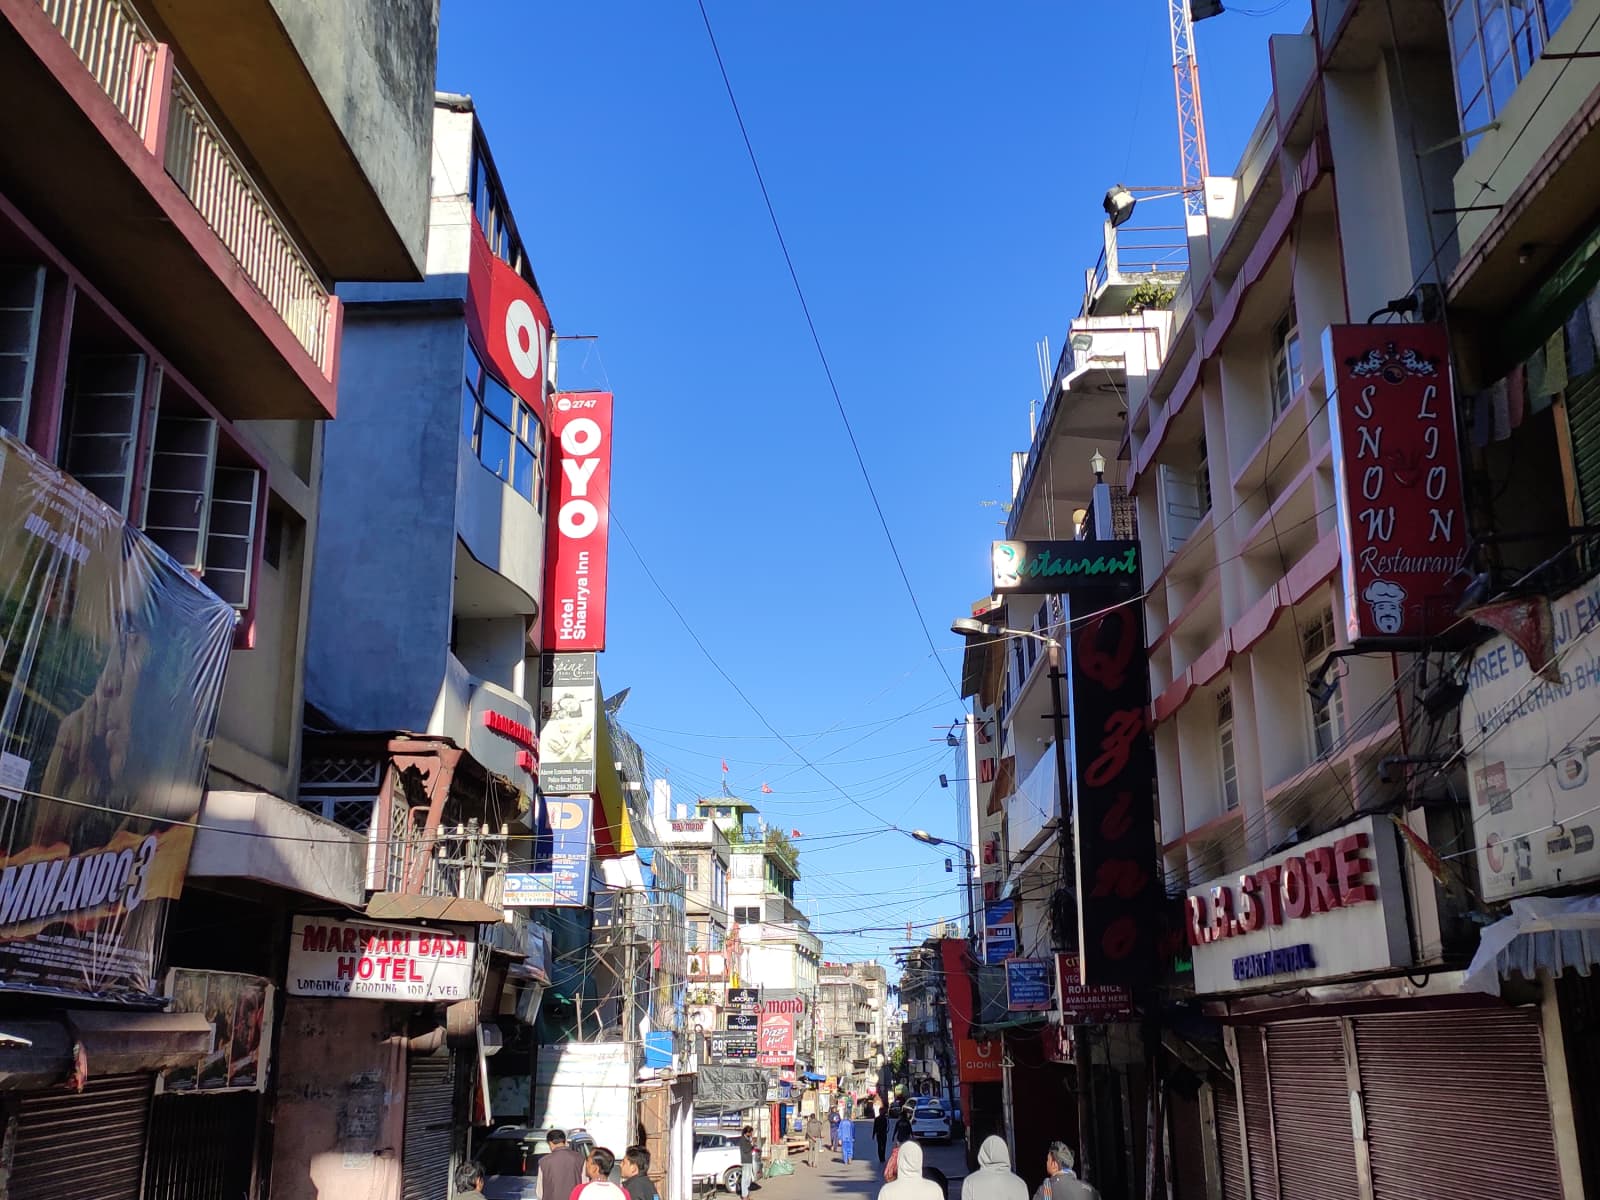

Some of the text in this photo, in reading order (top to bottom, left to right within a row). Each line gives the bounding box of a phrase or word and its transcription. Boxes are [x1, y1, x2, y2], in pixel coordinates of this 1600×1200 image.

[572, 400, 597, 409] 2747
[558, 417, 602, 539] OYO
[1355, 384, 1395, 543] SNOW
[1418, 384, 1454, 543] LION
[998, 544, 1137, 580] Restaurant
[573, 551, 591, 640] Shaurya Inn
[559, 598, 574, 640] Hotel
[125, 834, 158, 912] 3
[302, 924, 468, 959] MARWARI BASA
[337, 956, 424, 982] HOTEL
[297, 978, 341, 993] LODGING
[343, 981, 350, 993] &
[355, 981, 397, 994] FOODING
[438, 985, 459, 996] VEG
[1065, 995, 1107, 1004] AVAILABLE
[1067, 985, 1090, 995] ROTI
[762, 1027, 789, 1038] Pizza
[765, 1036, 785, 1048] Hut
